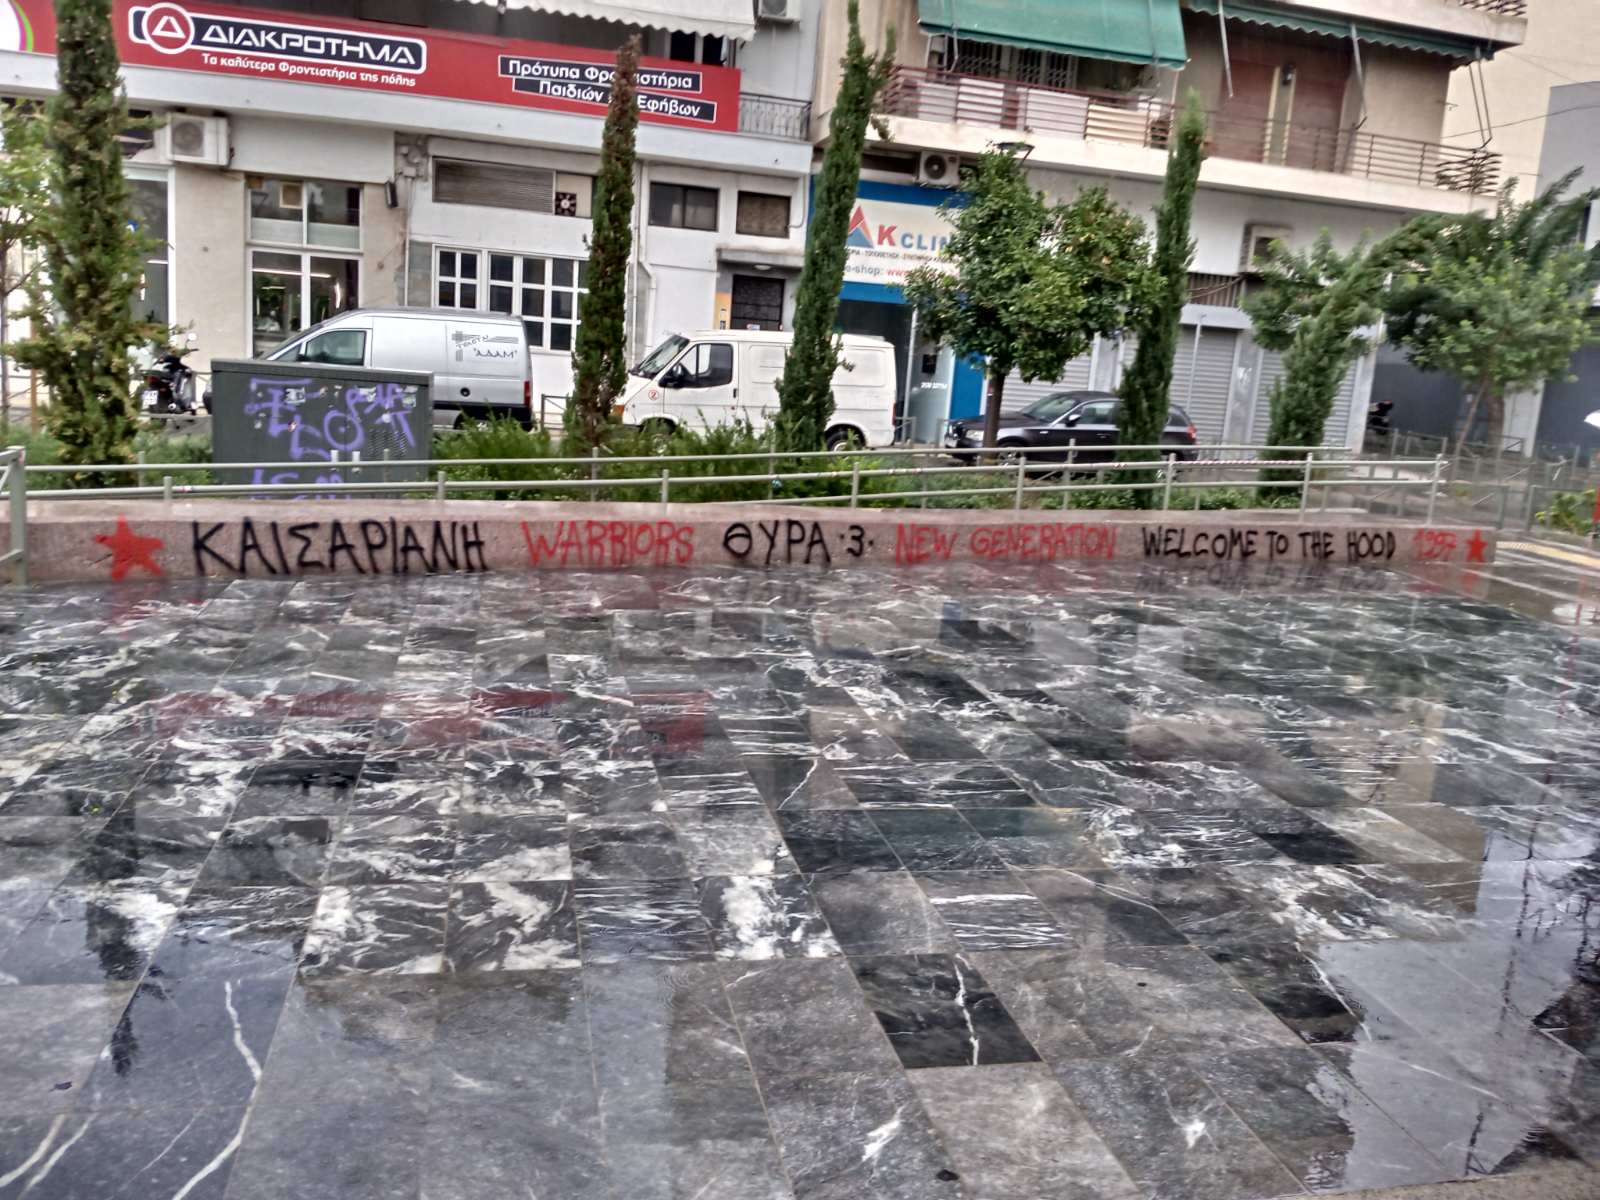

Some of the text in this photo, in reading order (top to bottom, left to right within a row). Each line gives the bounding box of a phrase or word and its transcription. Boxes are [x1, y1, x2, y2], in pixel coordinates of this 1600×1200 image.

[202, 25, 416, 65] ΔΙΑΚΡΟΤΗΜΑ
[201, 53, 416, 87] Τα καλύτερα Φροντιστήρια της πόλης
[508, 59, 580, 79] Πρότυπα
[539, 80, 604, 102] Παιδιών
[637, 94, 701, 117] Εφήβων
[191, 516, 489, 575] ΚΑΙΣΑΡΙΑΝΗ
[520, 519, 695, 566] WARRIORS
[723, 519, 831, 565] ΘΥΡΑ
[896, 522, 1118, 565] NEW GENERATION
[1142, 525, 1397, 563] WELCOME TO THE HOOD
